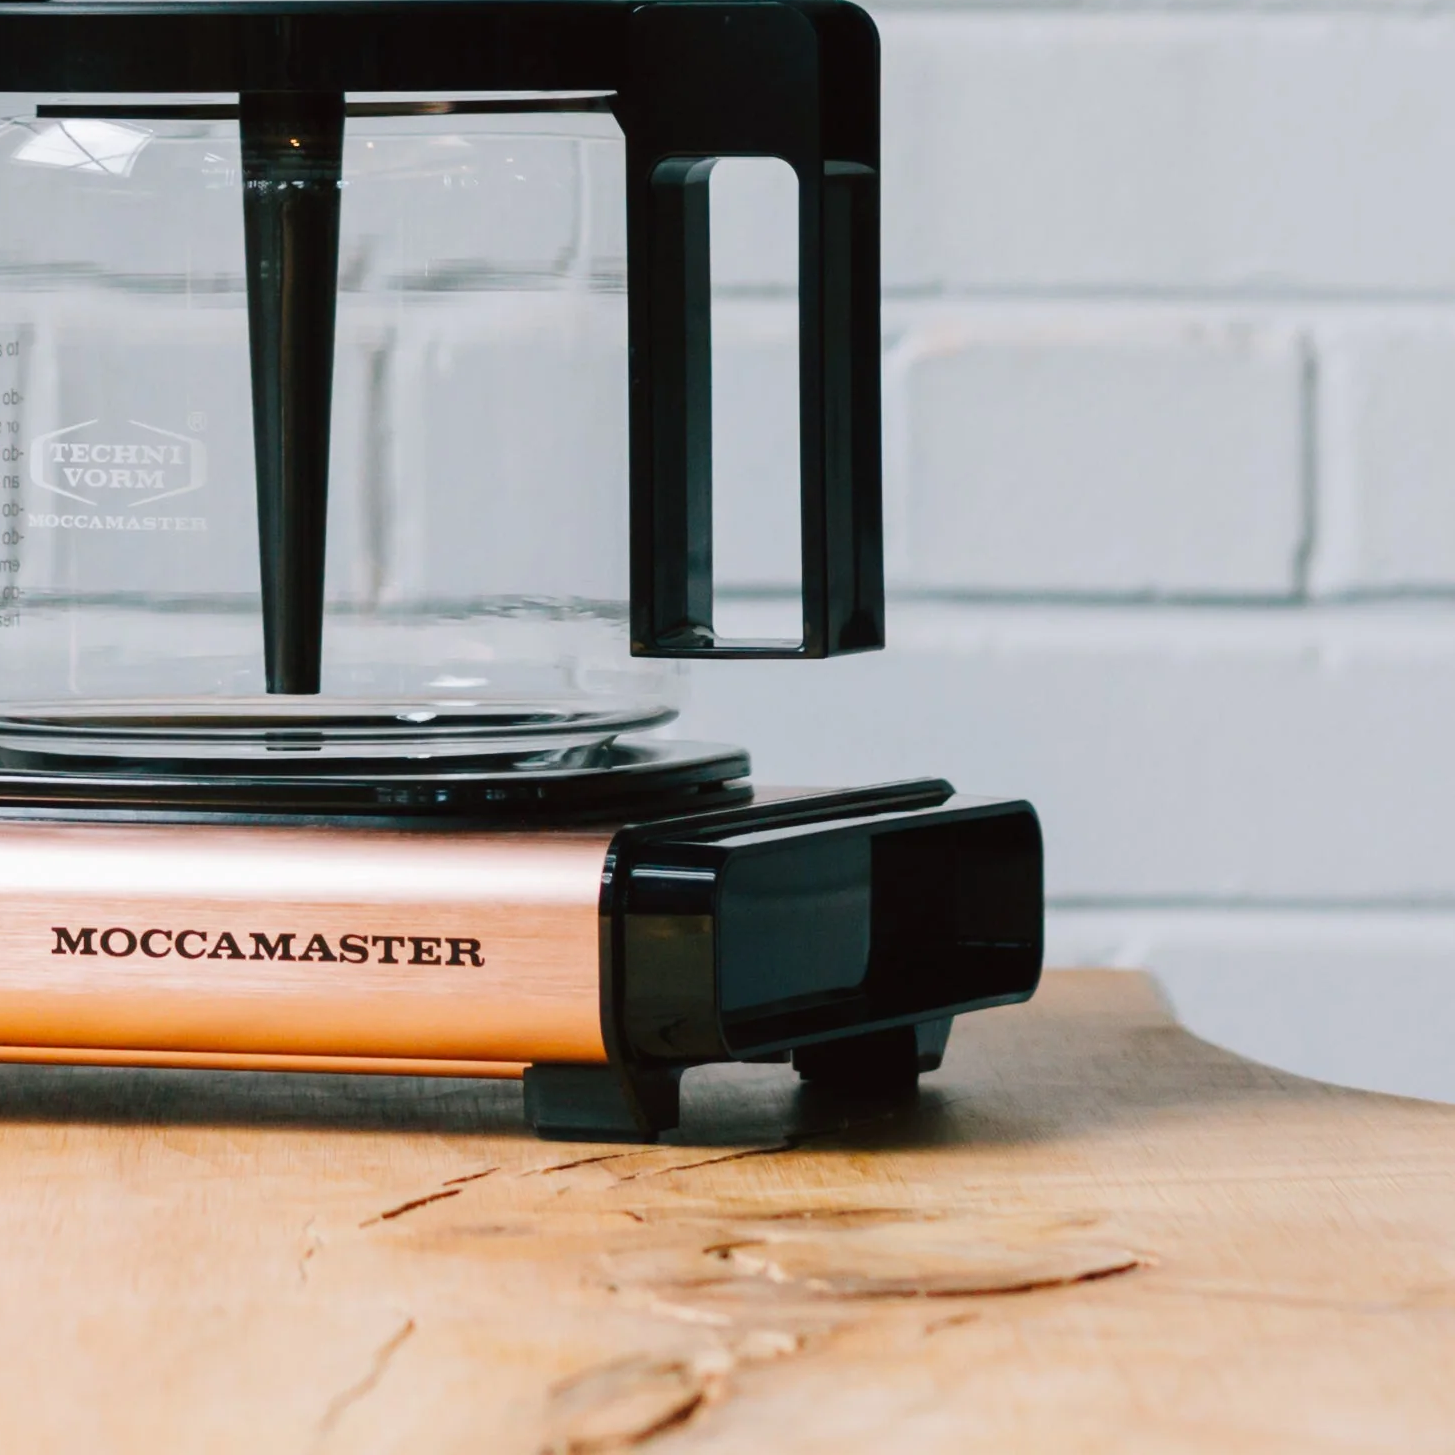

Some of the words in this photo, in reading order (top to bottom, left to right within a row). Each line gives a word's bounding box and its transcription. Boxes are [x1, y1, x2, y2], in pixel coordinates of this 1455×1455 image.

[49, 443, 185, 465] TECHNI
[63, 467, 165, 489] VORM
[28, 513, 208, 532] MOCCAMASTER
[51, 927, 485, 968] MOCCAMASTER
